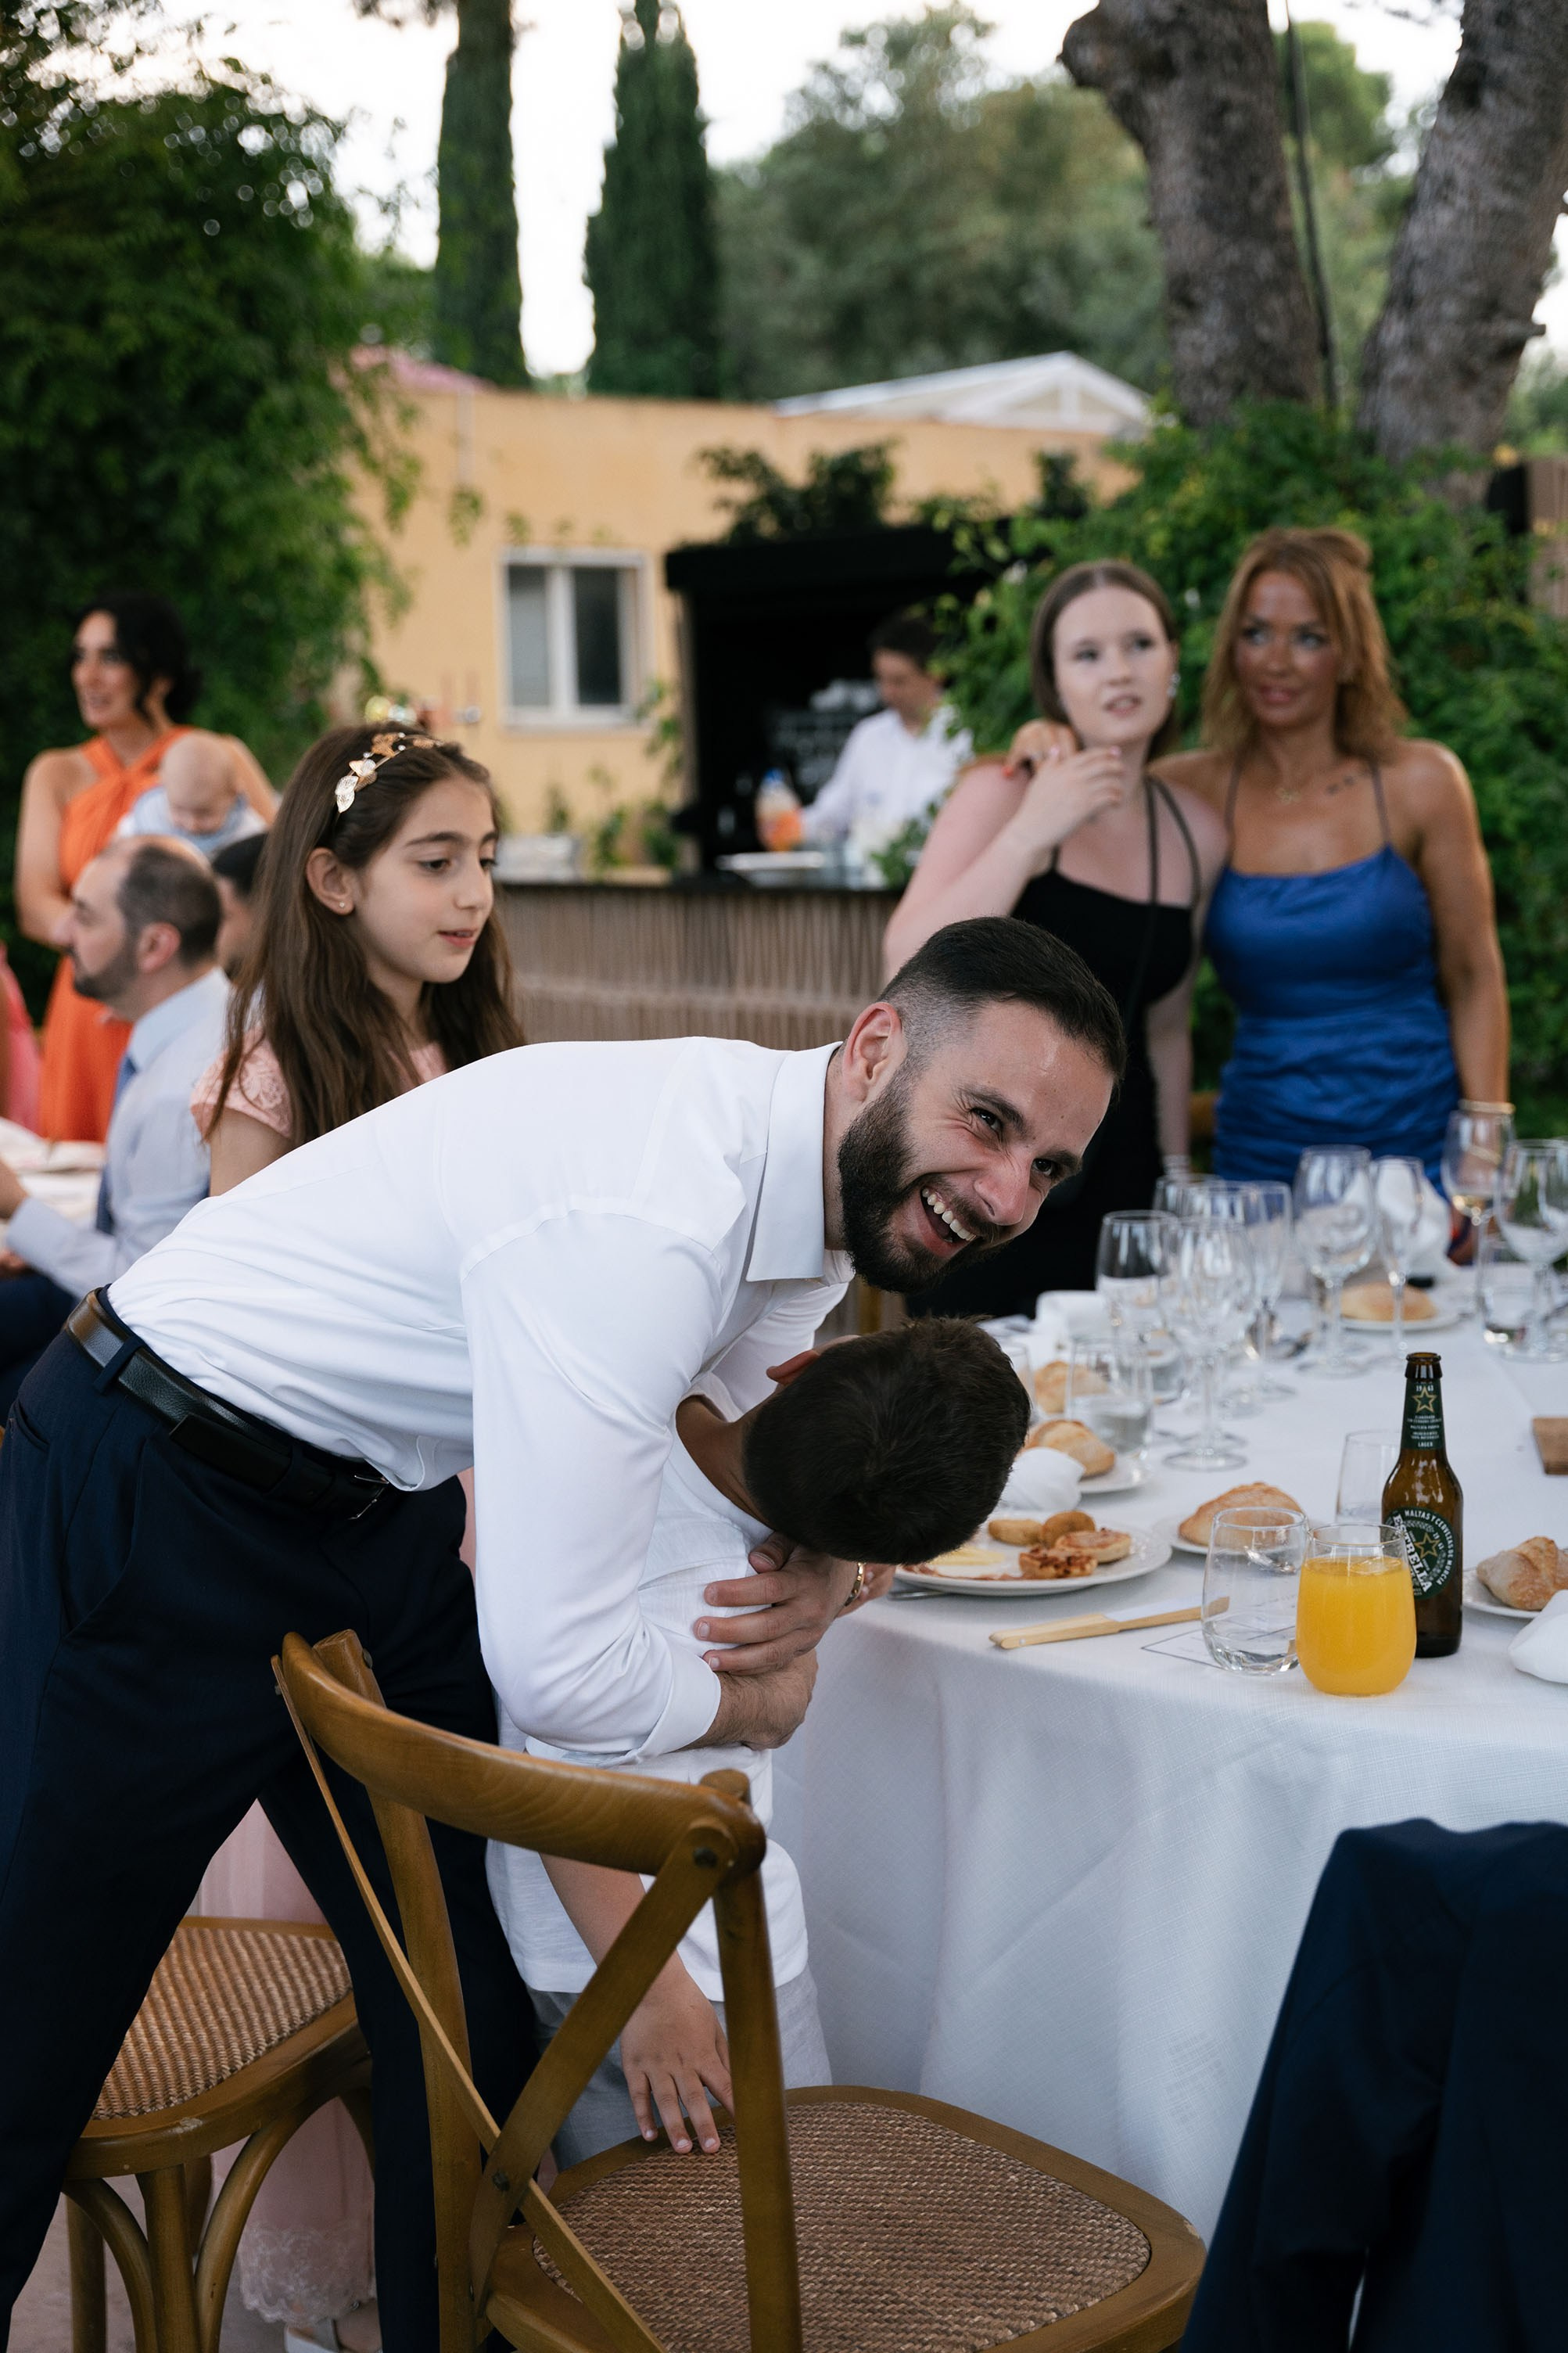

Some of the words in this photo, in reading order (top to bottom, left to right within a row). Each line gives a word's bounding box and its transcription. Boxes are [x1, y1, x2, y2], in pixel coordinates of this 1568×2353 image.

[1405, 1510, 1430, 1520] MALTAS
[1434, 1518, 1454, 1549] CERVEZAS
[1393, 1514, 1433, 1593] ESTRELLA
[1448, 1549, 1454, 1557] DE
[1436, 1560, 1452, 1585] MURCIA
